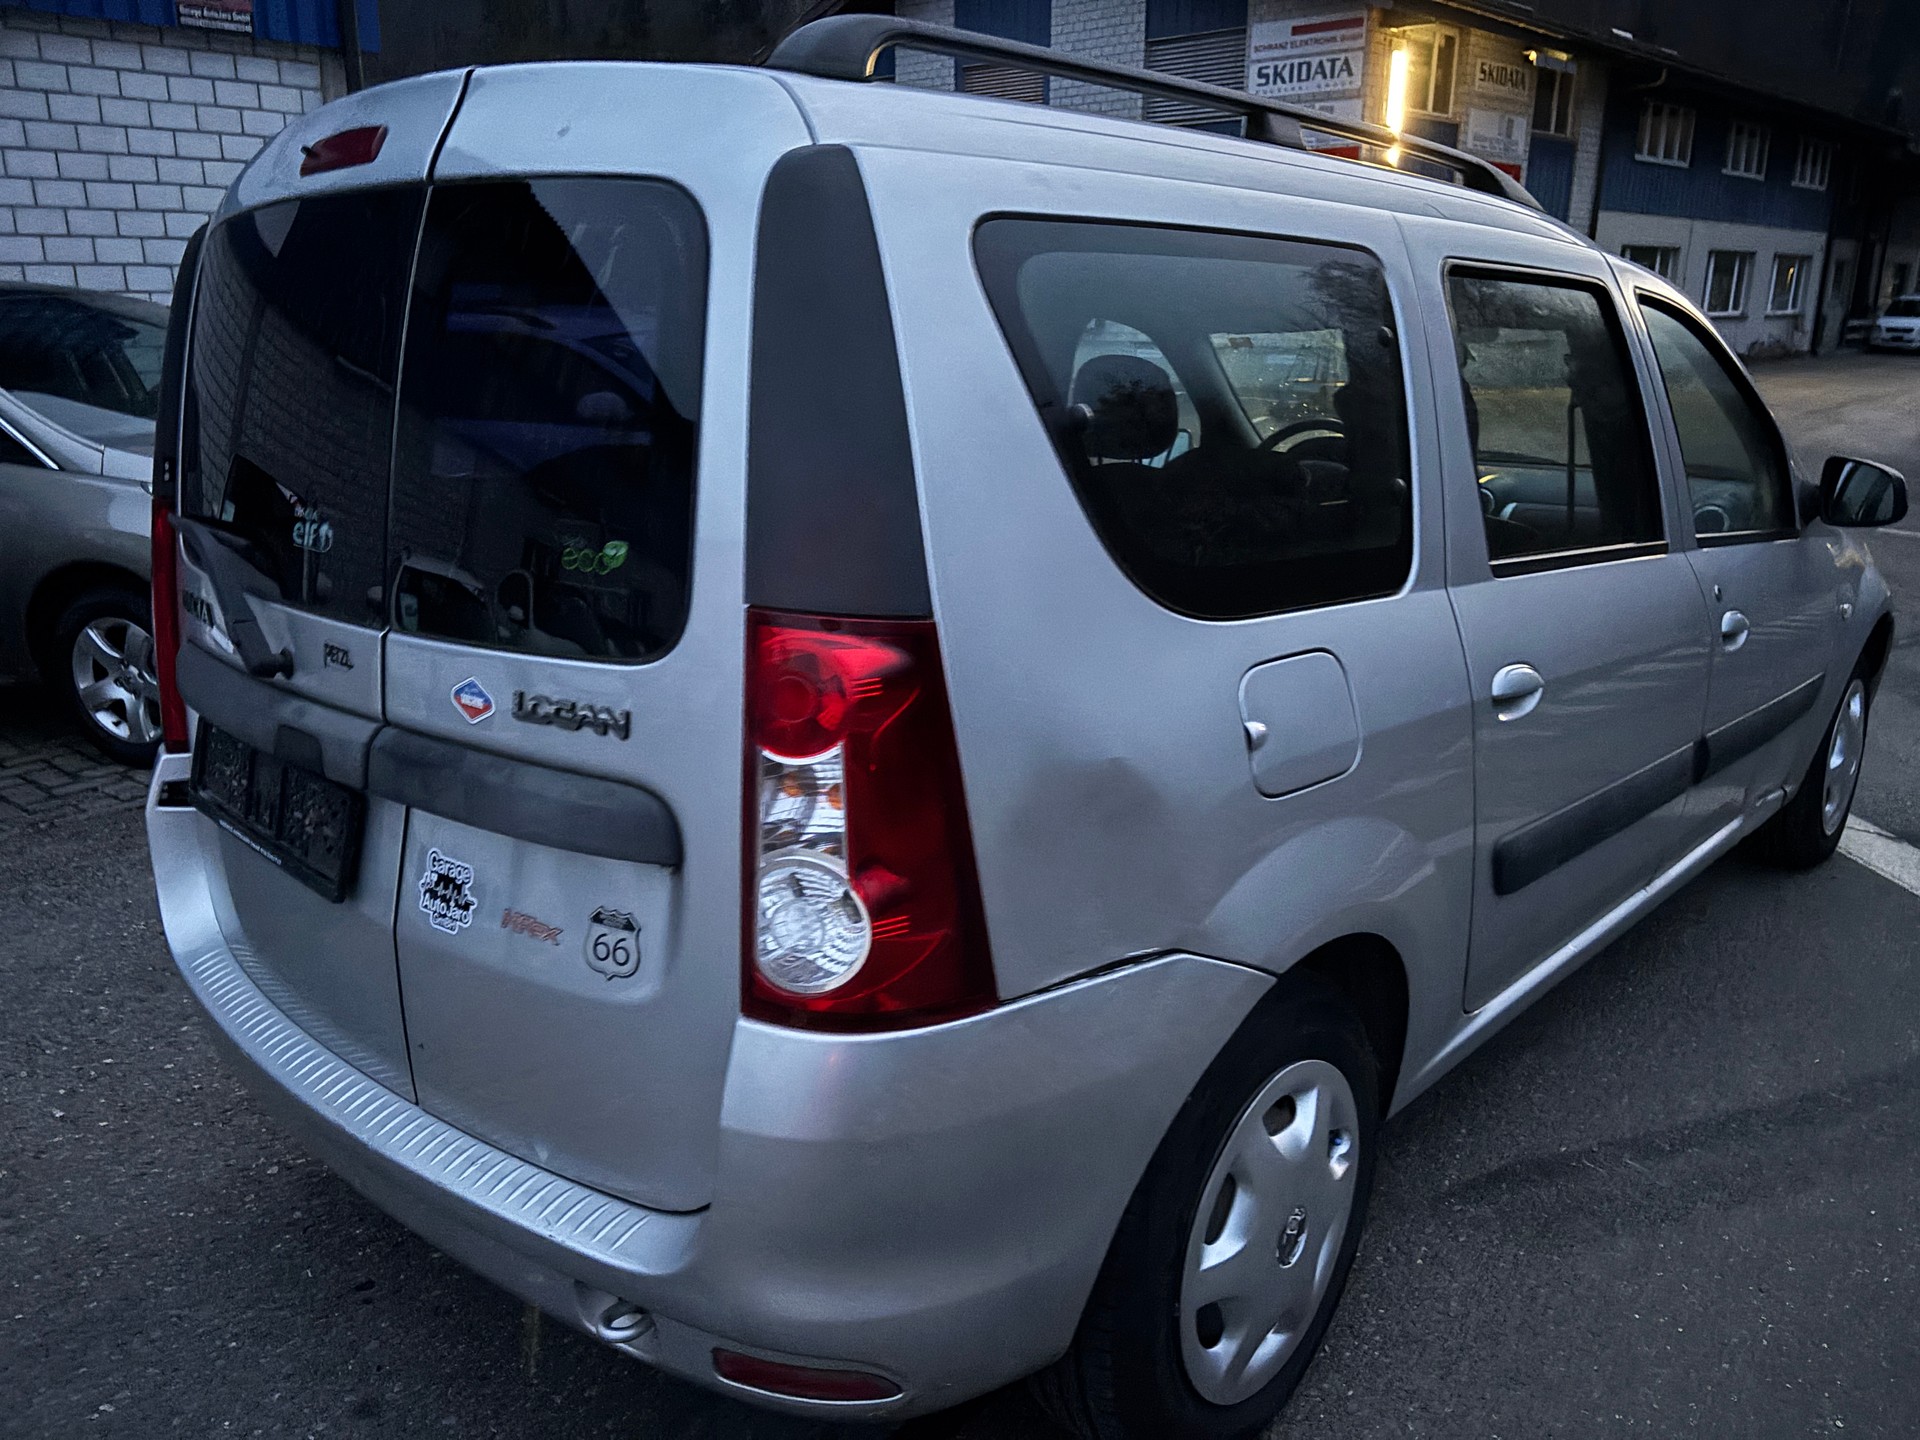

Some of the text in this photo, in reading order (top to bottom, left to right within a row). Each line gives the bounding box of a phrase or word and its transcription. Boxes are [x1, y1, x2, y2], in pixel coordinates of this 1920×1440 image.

[1256, 56, 1353, 87] SKIDATA
[1480, 62, 1526, 91] SKIDATA
[511, 689, 632, 741] LOGAN
[430, 851, 471, 884] Garage
[593, 933, 630, 967] 66
